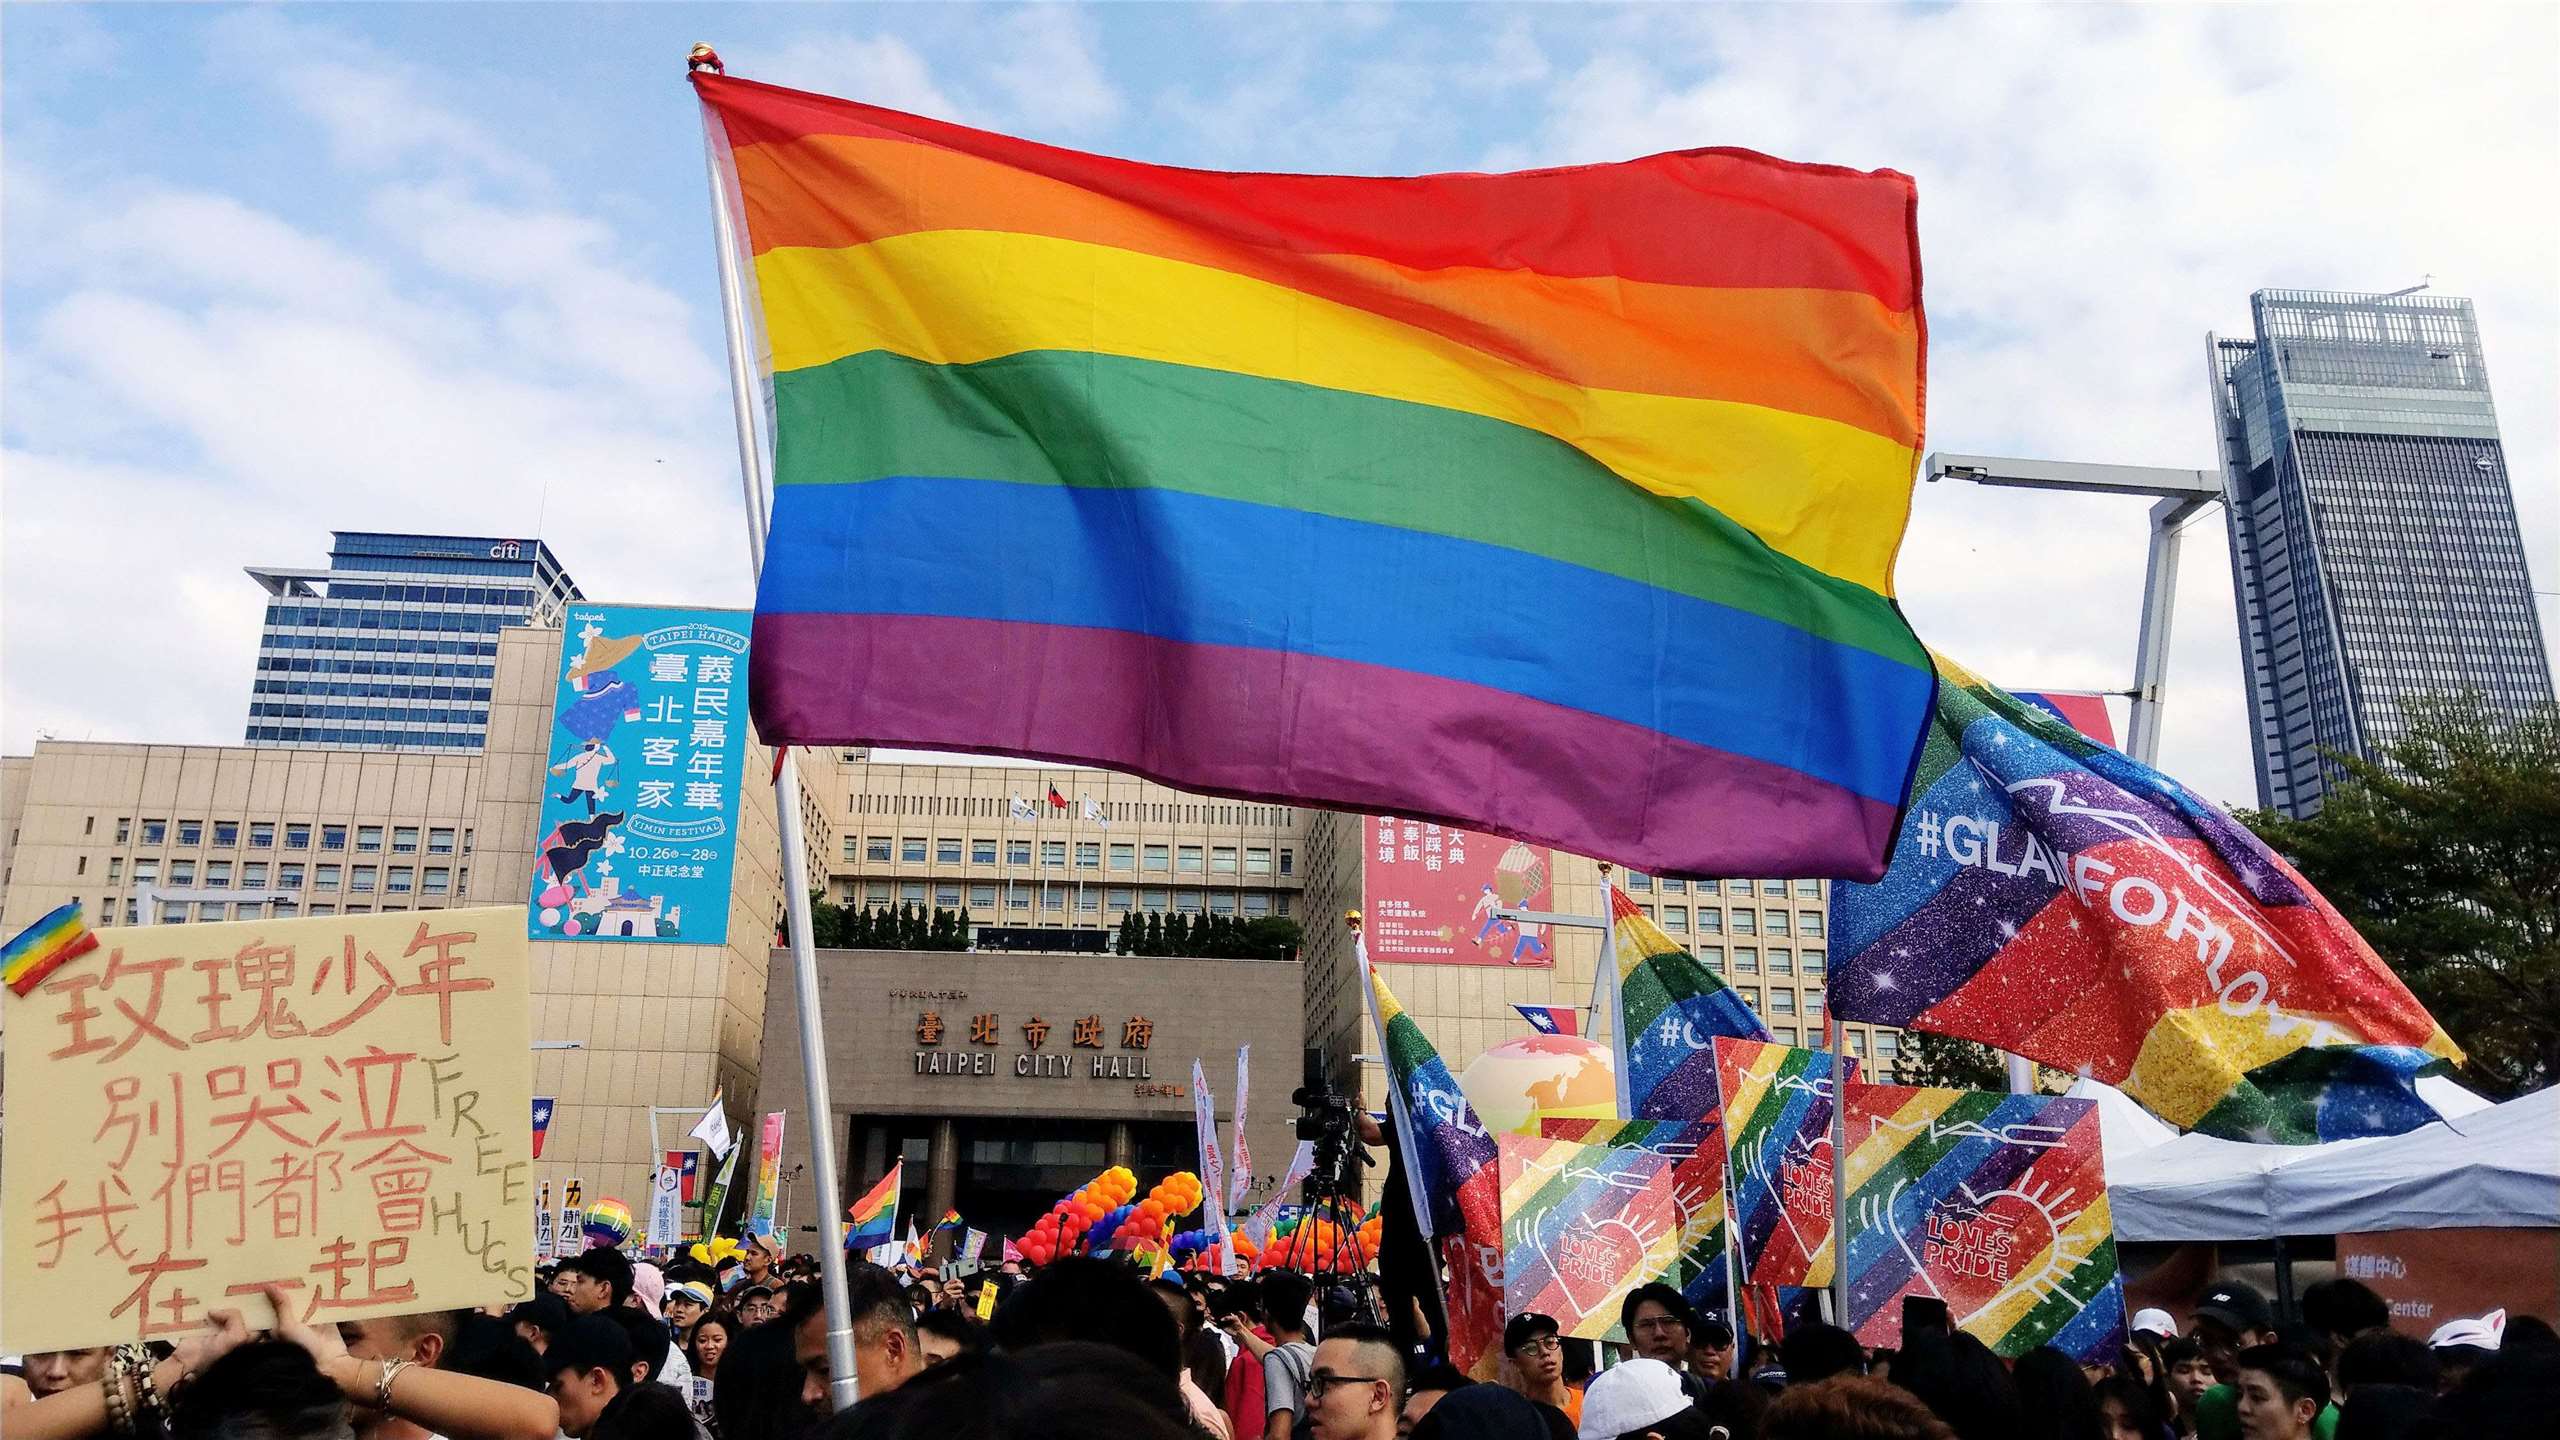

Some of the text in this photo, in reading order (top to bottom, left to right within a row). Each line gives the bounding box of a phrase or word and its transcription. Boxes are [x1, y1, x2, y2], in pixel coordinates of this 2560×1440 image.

[490, 540, 520, 559] citi
[650, 630, 742, 649] TAIPEI HAKKA
[636, 653, 690, 809] 臺北客家
[683, 655, 735, 810] 義民嘉年華
[633, 820, 720, 836] YIMIN FESTIVAL
[1448, 829, 1465, 865] 大典
[638, 864, 705, 879] 中正紀念堂
[44, 921, 496, 1063] 玫瑰少年
[916, 1009, 1153, 1050] 臺北市政府
[916, 1052, 1151, 1078] TAIPEI CITY HALL
[94, 1045, 427, 1171] 別哭泣
[421, 1053, 527, 1206] FREE
[1782, 1161, 1831, 1198] LOVES
[34, 1138, 453, 1269] 我們都會
[1783, 1186, 1833, 1223] PRIDE
[431, 1191, 530, 1300] HUGS
[1560, 1235, 1618, 1269] LOVES
[1926, 1213, 2012, 1257] LOVES
[1559, 1254, 1617, 1288] PRIDE
[1923, 1240, 2010, 1283] PRIDE
[2344, 1255, 2407, 1279] 媒體中心
[110, 1235, 419, 1341] 在一起
